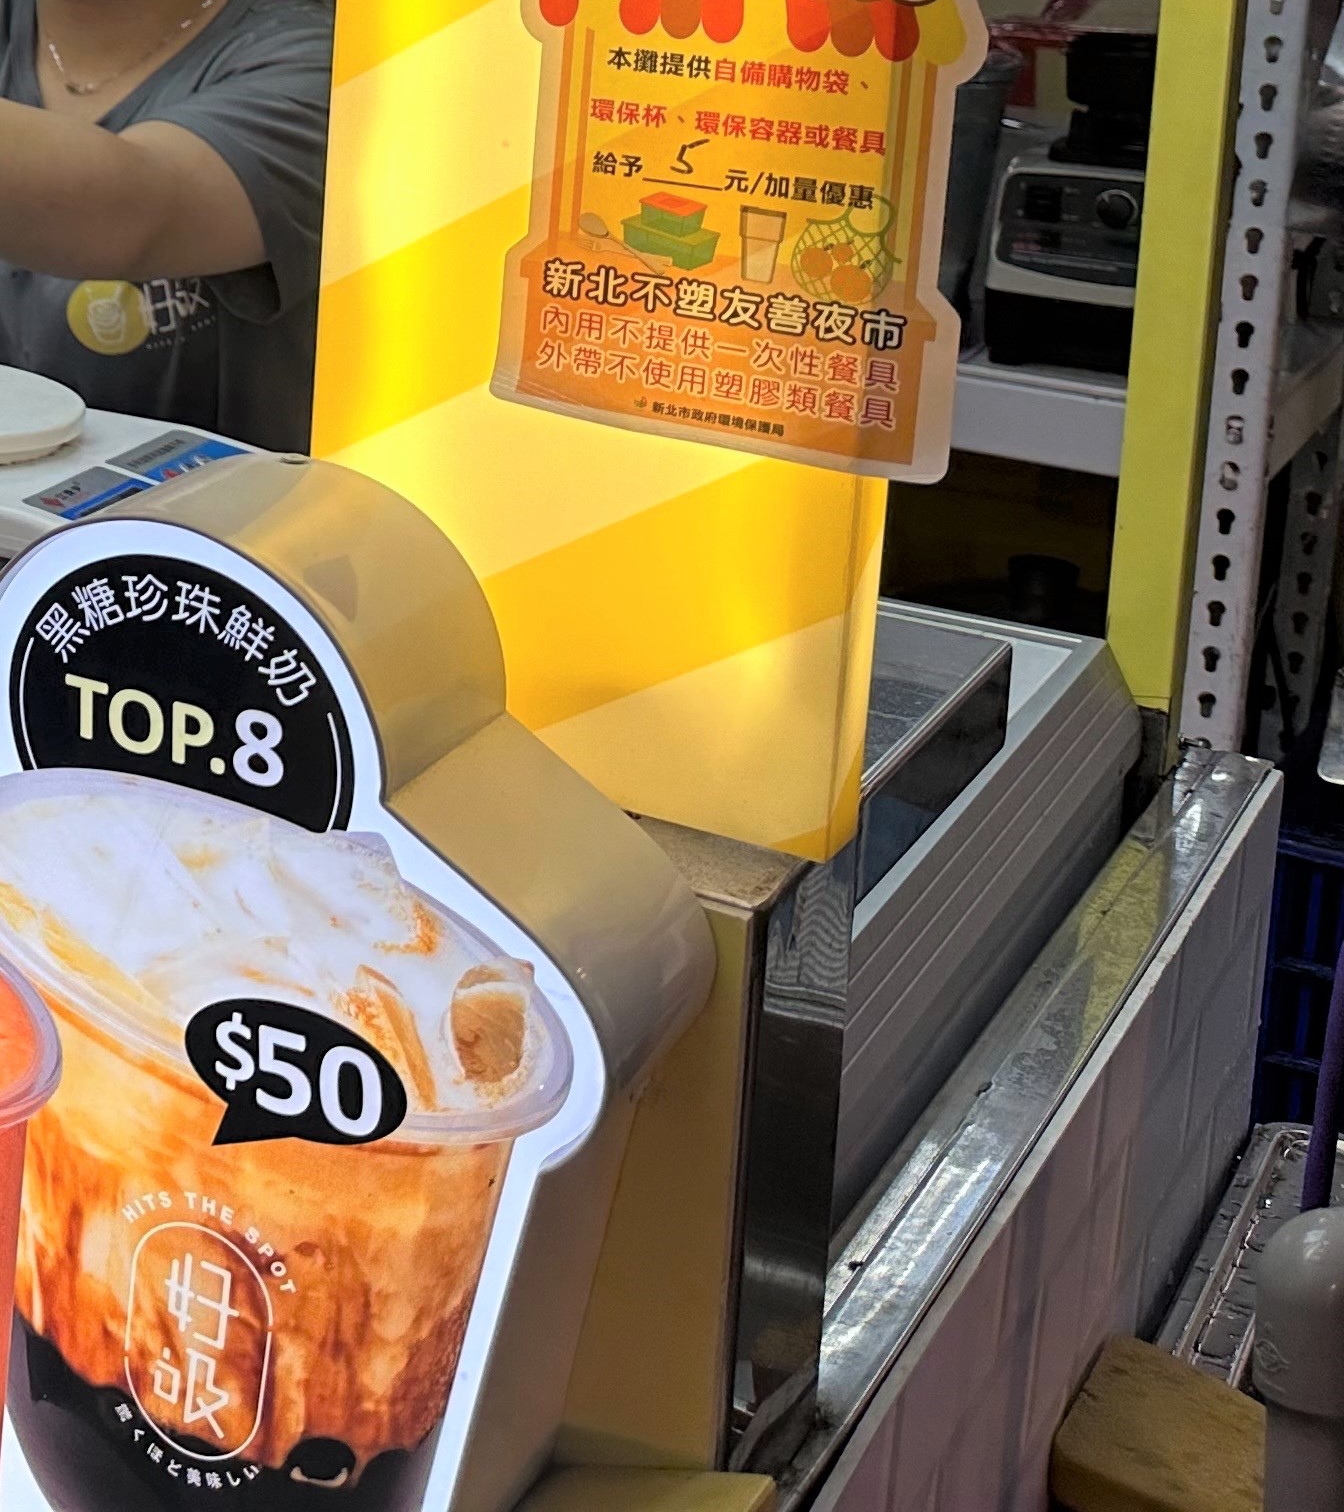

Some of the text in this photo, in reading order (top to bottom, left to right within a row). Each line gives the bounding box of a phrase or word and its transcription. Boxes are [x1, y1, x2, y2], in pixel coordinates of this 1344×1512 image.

[592, 151, 643, 178] 給予
[670, 139, 711, 175] 5
[543, 258, 907, 351] 新北不塑友善夜市
[36, 573, 317, 707] 黑糖珍珠鮮奶
[64, 673, 285, 788] TOP.8
[215, 1012, 382, 1138] $50
[121, 1190, 296, 1294] HITS THE SPOT
